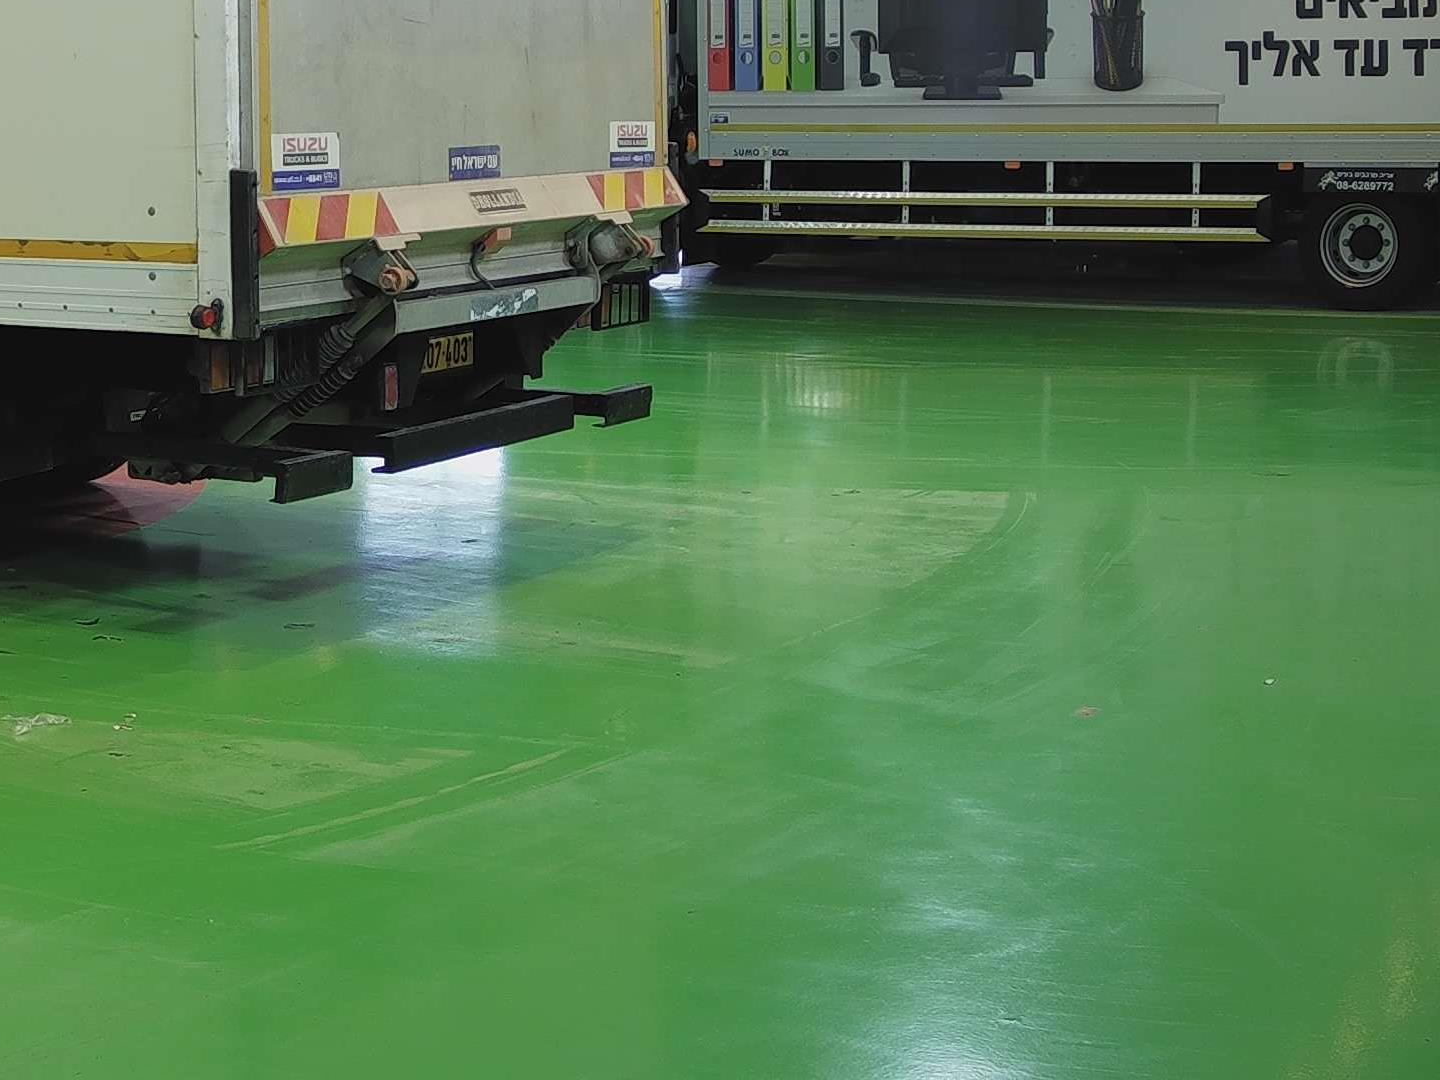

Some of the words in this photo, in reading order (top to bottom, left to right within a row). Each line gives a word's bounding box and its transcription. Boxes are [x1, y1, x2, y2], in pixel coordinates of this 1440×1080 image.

[1224, 30, 1321, 86] אליך
[1333, 39, 1389, 77] עד
[617, 124, 648, 137] ISUZU
[282, 136, 328, 153] ISUZU
[733, 148, 760, 157] SUMO
[771, 148, 789, 157] BOX
[462, 153, 486, 170] ישראל
[487, 154, 498, 169] עם
